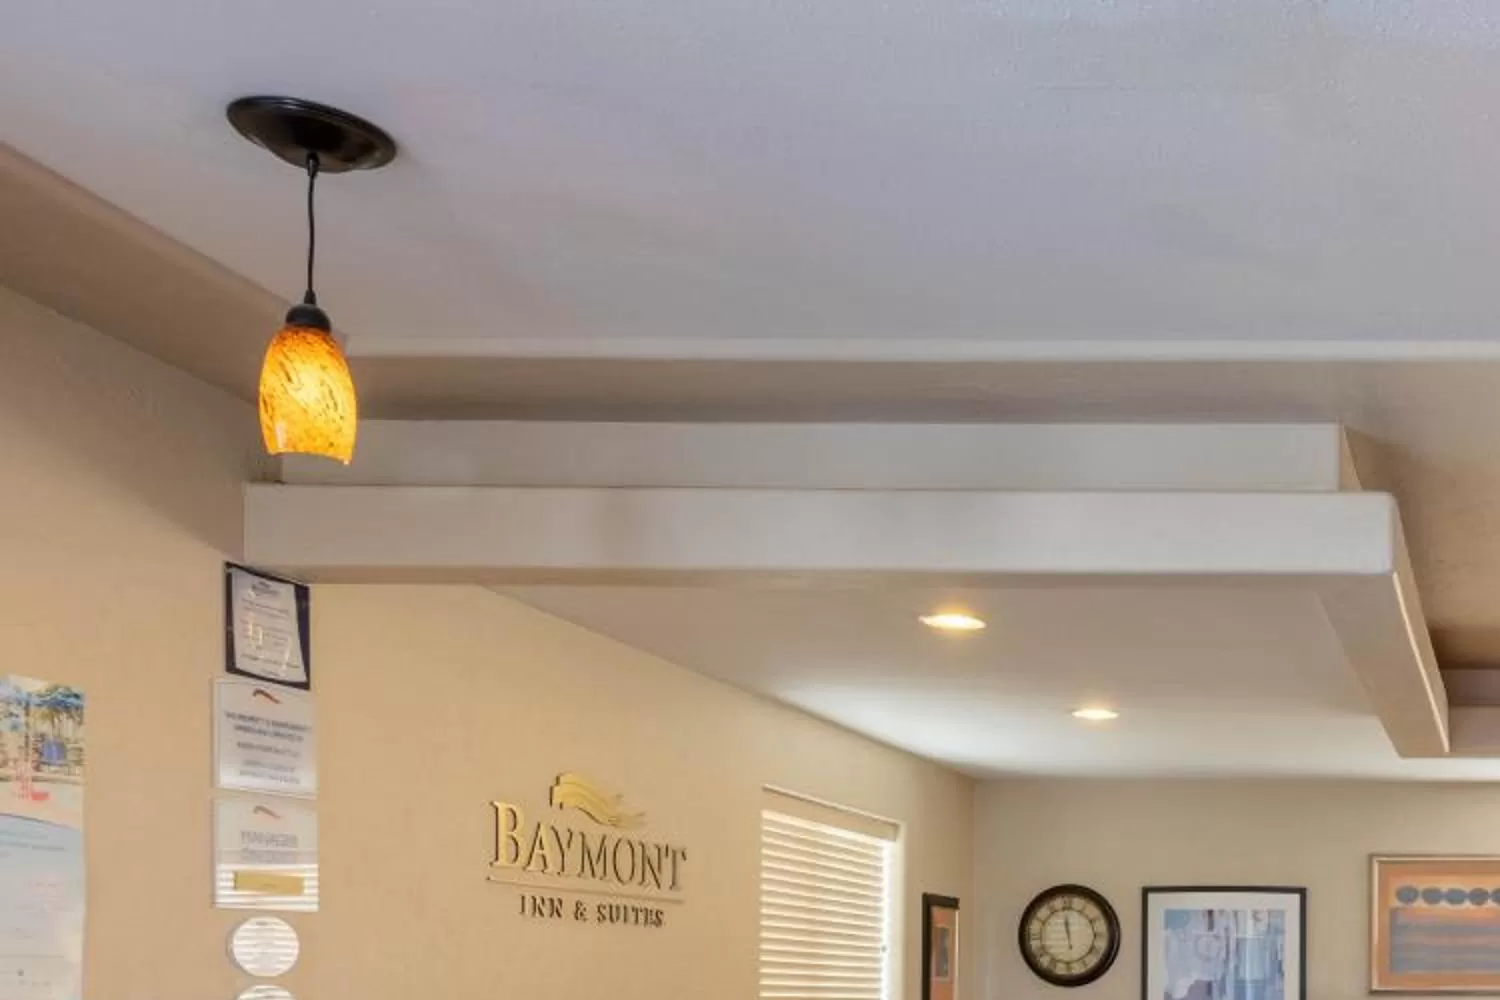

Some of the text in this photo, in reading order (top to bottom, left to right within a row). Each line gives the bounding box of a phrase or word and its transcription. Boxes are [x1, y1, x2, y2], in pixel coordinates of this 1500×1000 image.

[488, 800, 687, 891] BAYMONT
[518, 894, 665, 928] INN & SUITES
